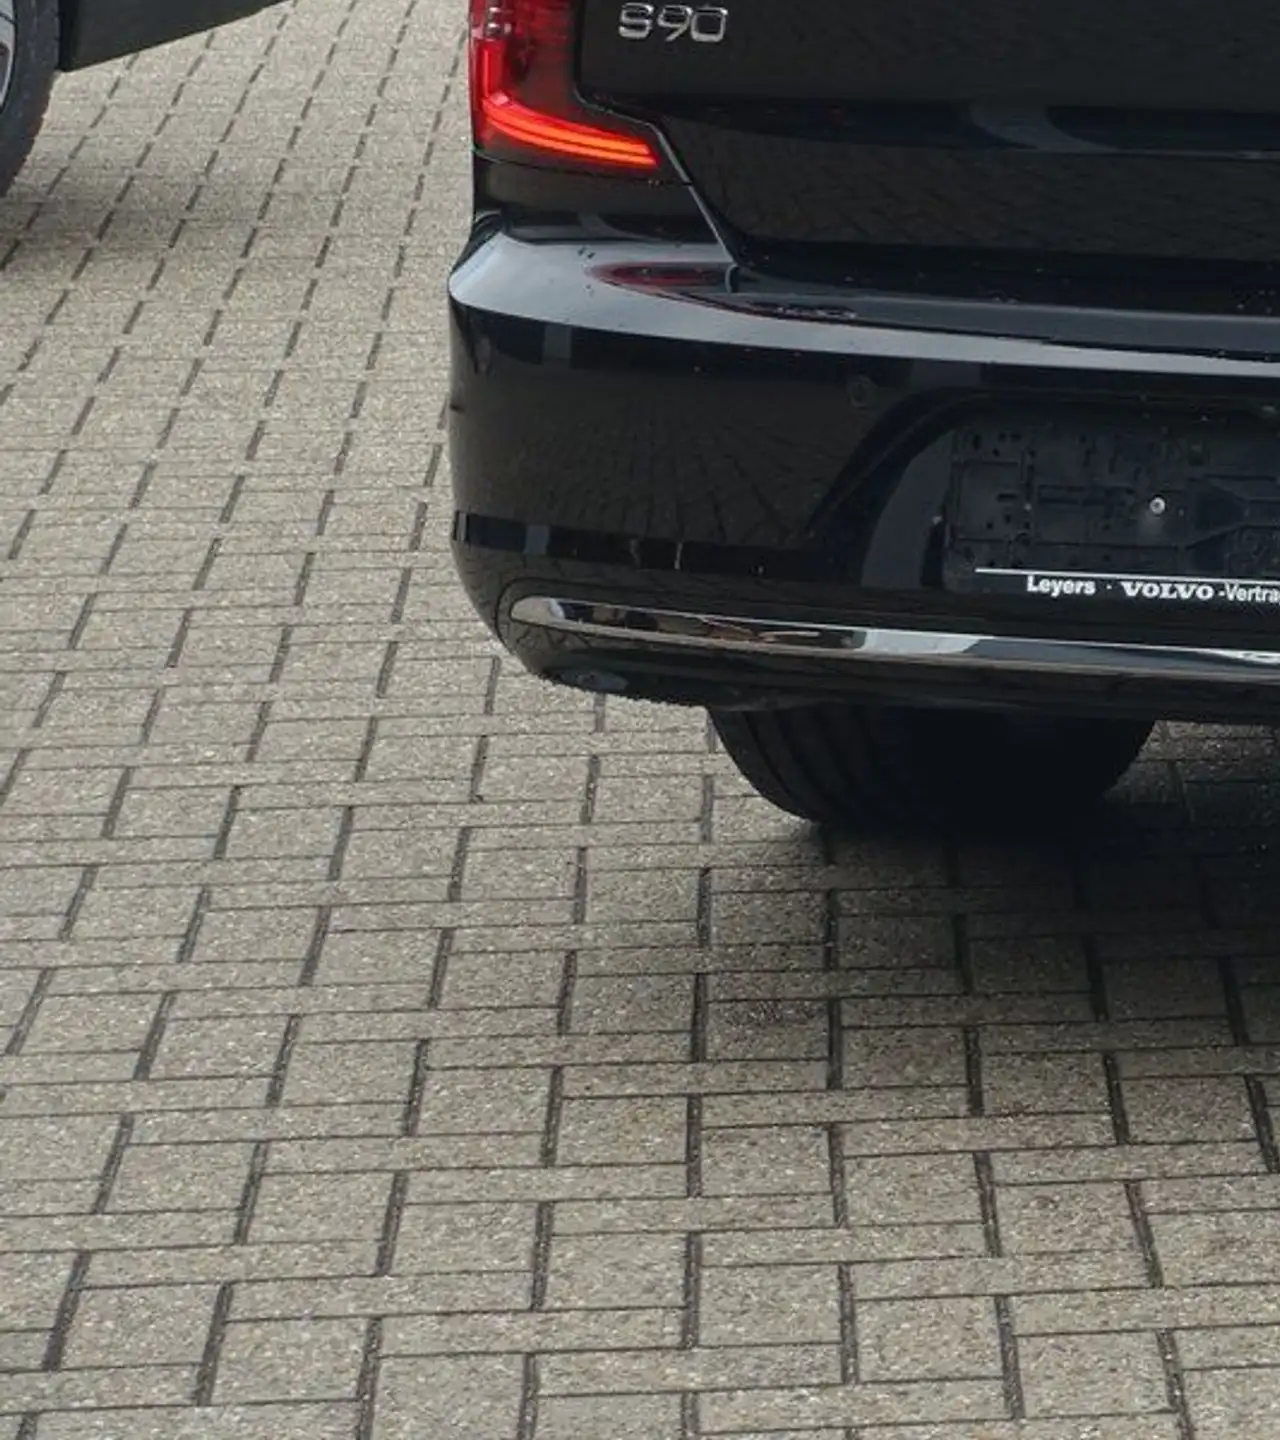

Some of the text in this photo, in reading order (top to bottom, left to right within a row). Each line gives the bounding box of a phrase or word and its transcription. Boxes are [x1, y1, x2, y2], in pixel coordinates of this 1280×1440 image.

[618, 1, 729, 42] S90
[1027, 575, 1096, 597] Leyers
[1120, 581, 1213, 600] VOLVO
